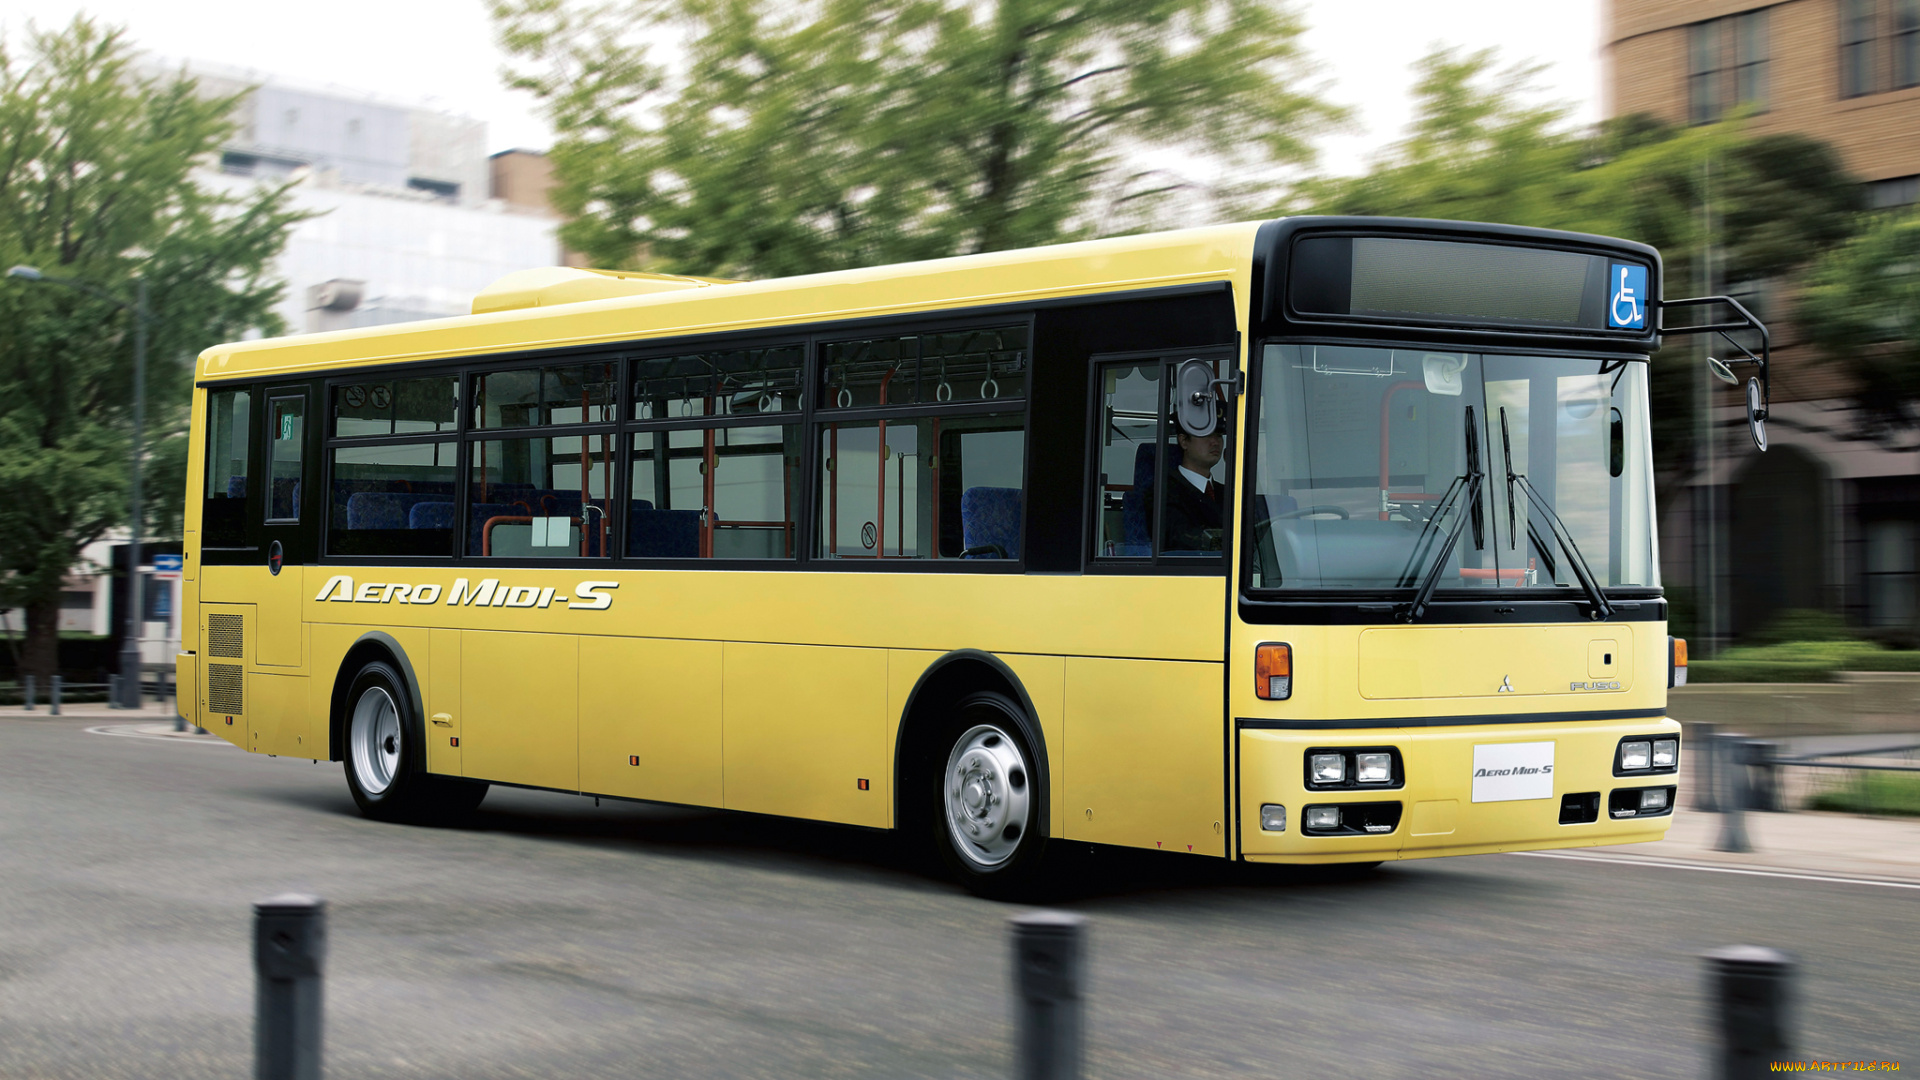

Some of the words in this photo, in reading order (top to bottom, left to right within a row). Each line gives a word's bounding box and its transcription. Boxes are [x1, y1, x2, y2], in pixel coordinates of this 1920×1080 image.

[315, 575, 442, 605] AERO
[446, 577, 620, 610] MIDI-S
[1570, 681, 1621, 691] FUSO
[1474, 768, 1511, 778] AERO
[1511, 765, 1553, 775] MIDI-S
